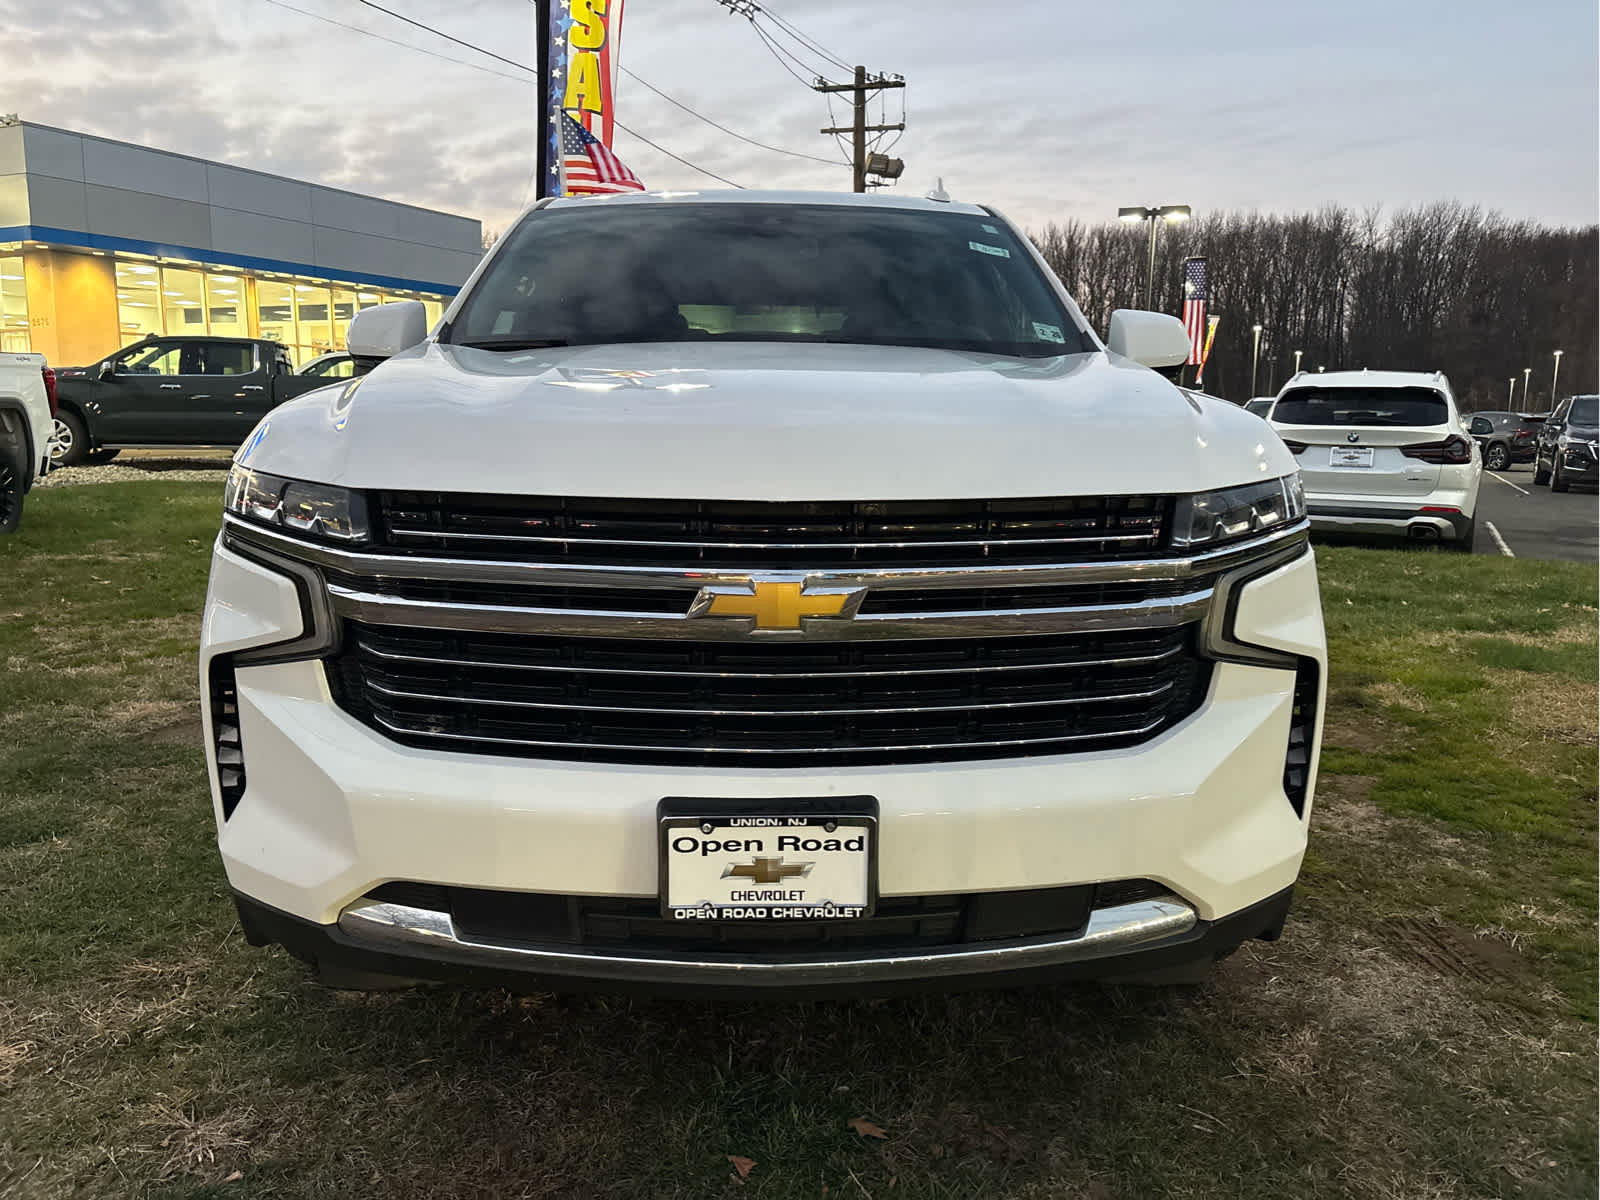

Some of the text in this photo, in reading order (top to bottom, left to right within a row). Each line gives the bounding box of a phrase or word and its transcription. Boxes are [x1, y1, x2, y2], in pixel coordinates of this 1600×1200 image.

[563, 0, 607, 124] SA
[730, 817, 808, 827] UNION, NJ
[672, 835, 865, 856] Open Road
[730, 890, 805, 902] CHEVROLET
[674, 907, 863, 920] OPEN ROAD CHEVROLET
